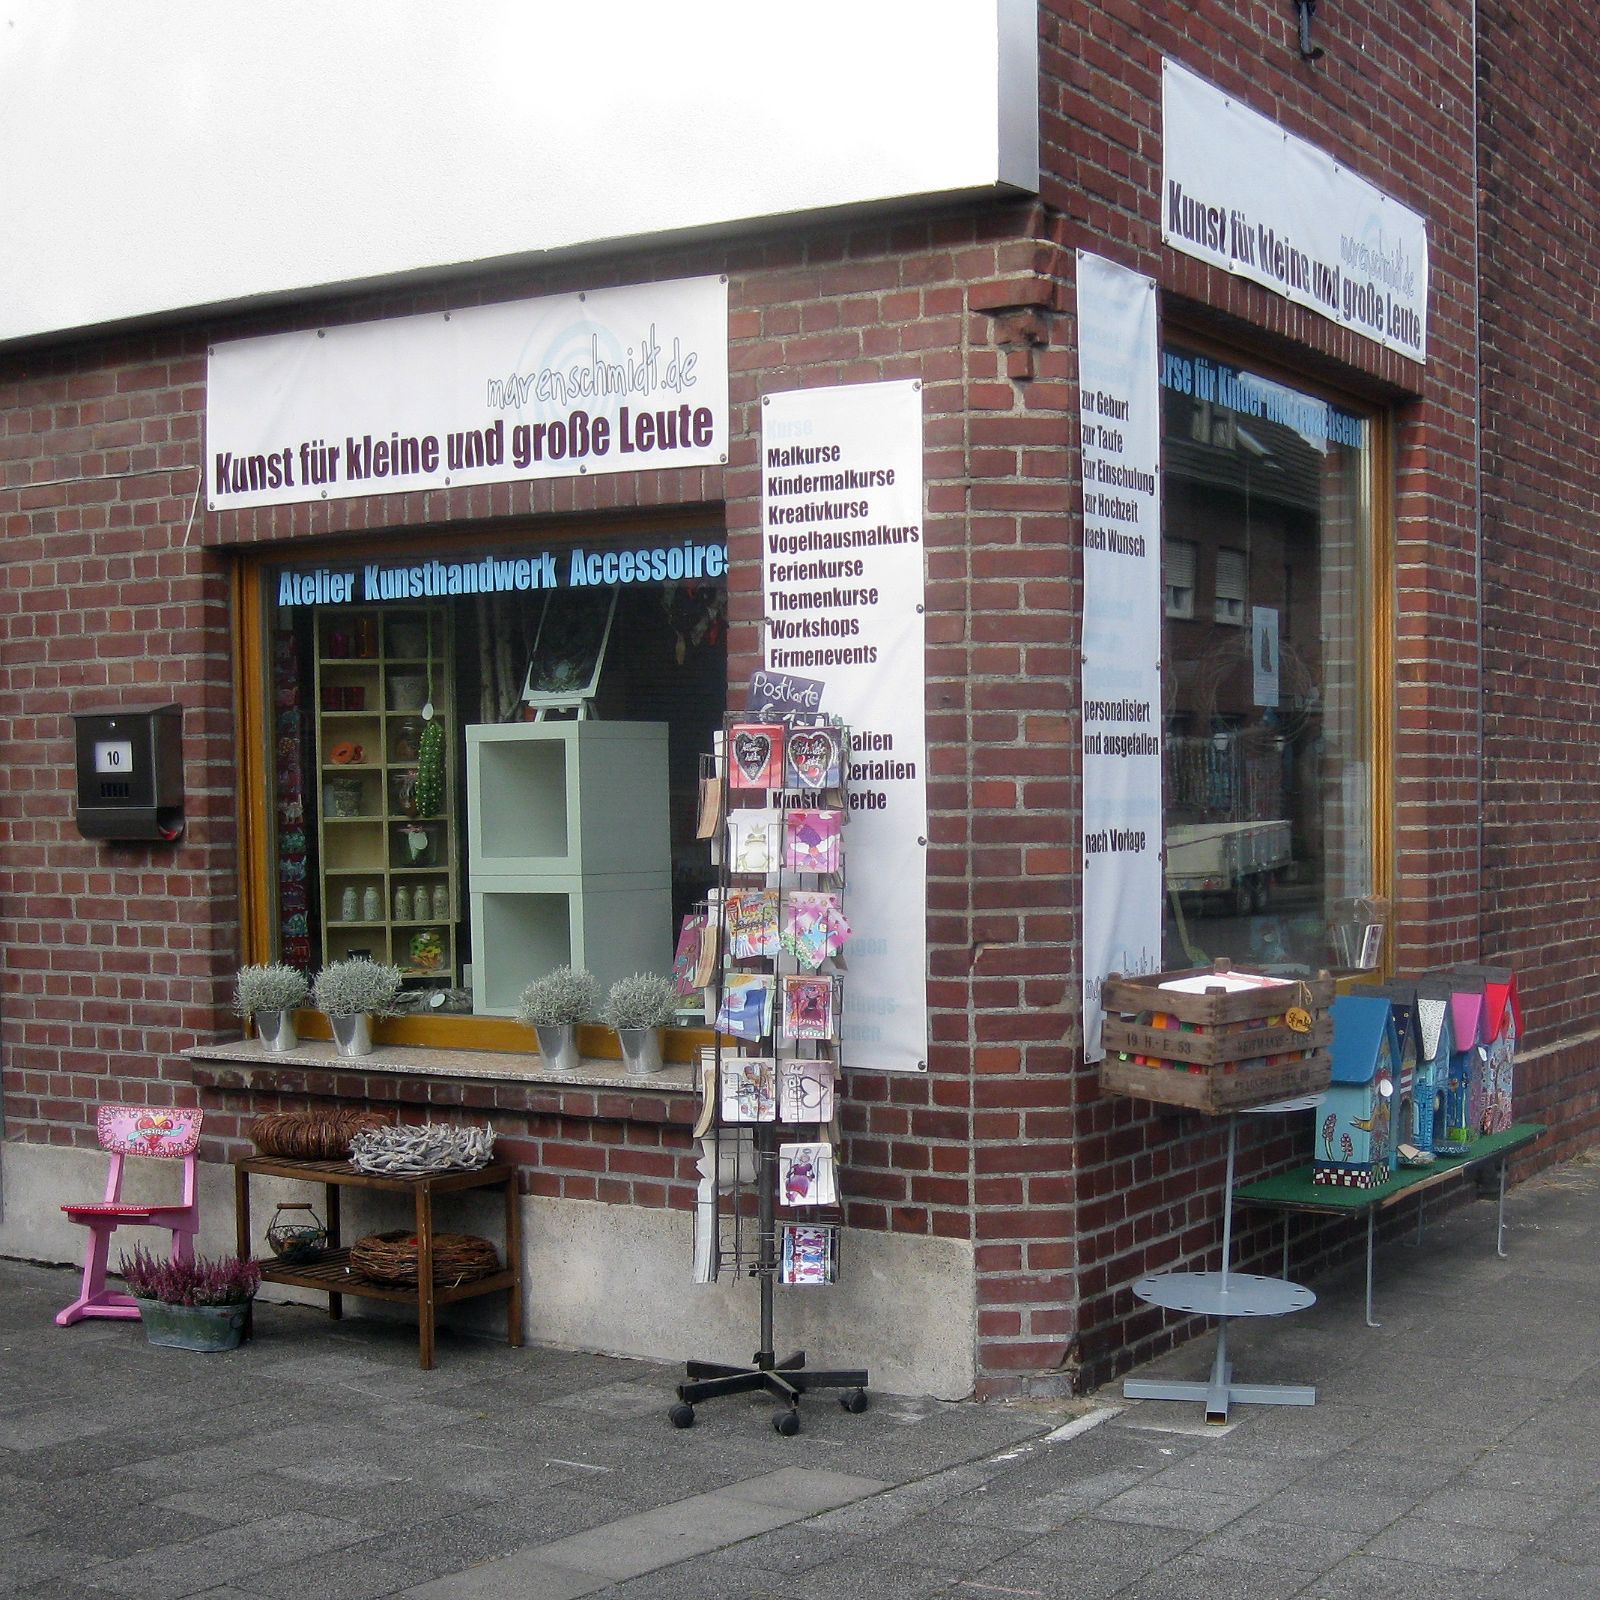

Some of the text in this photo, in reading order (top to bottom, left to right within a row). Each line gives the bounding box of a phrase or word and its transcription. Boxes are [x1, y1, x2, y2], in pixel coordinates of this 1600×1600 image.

[1168, 179, 1421, 351] Kunst für kleine und große Leute
[487, 323, 698, 409] marenschmidt.de
[1194, 358, 1216, 403] für
[1081, 390, 1129, 422] zur Geburt
[216, 404, 713, 495] Kunst für kleine und große Leute
[1082, 424, 1123, 453] zur Taufe
[768, 445, 840, 468] Malkurse
[768, 468, 895, 496] Kindermalkurse
[1083, 459, 1155, 496] zur Einschulung
[768, 500, 868, 525] Kreativkurse
[1084, 493, 1138, 523] zur Hochzeit
[769, 525, 919, 554] Vogelhausmalkurs
[1084, 527, 1145, 557] nach Wunsch
[278, 540, 728, 607] Atelier Kunsthandwerk Accessoires
[769, 559, 863, 583] Ferienkurse
[770, 587, 878, 611] Themenkurse
[770, 617, 859, 640] Workshops
[770, 645, 877, 668] Firmenevents
[753, 671, 819, 707] Postkarte
[1084, 699, 1151, 723] personalisiert
[849, 731, 893, 751] alien
[1084, 732, 1159, 758] und ausgefallen
[107, 751, 120, 766] 10
[848, 759, 916, 781] terialien
[1085, 828, 1146, 853] nach Vorlage
